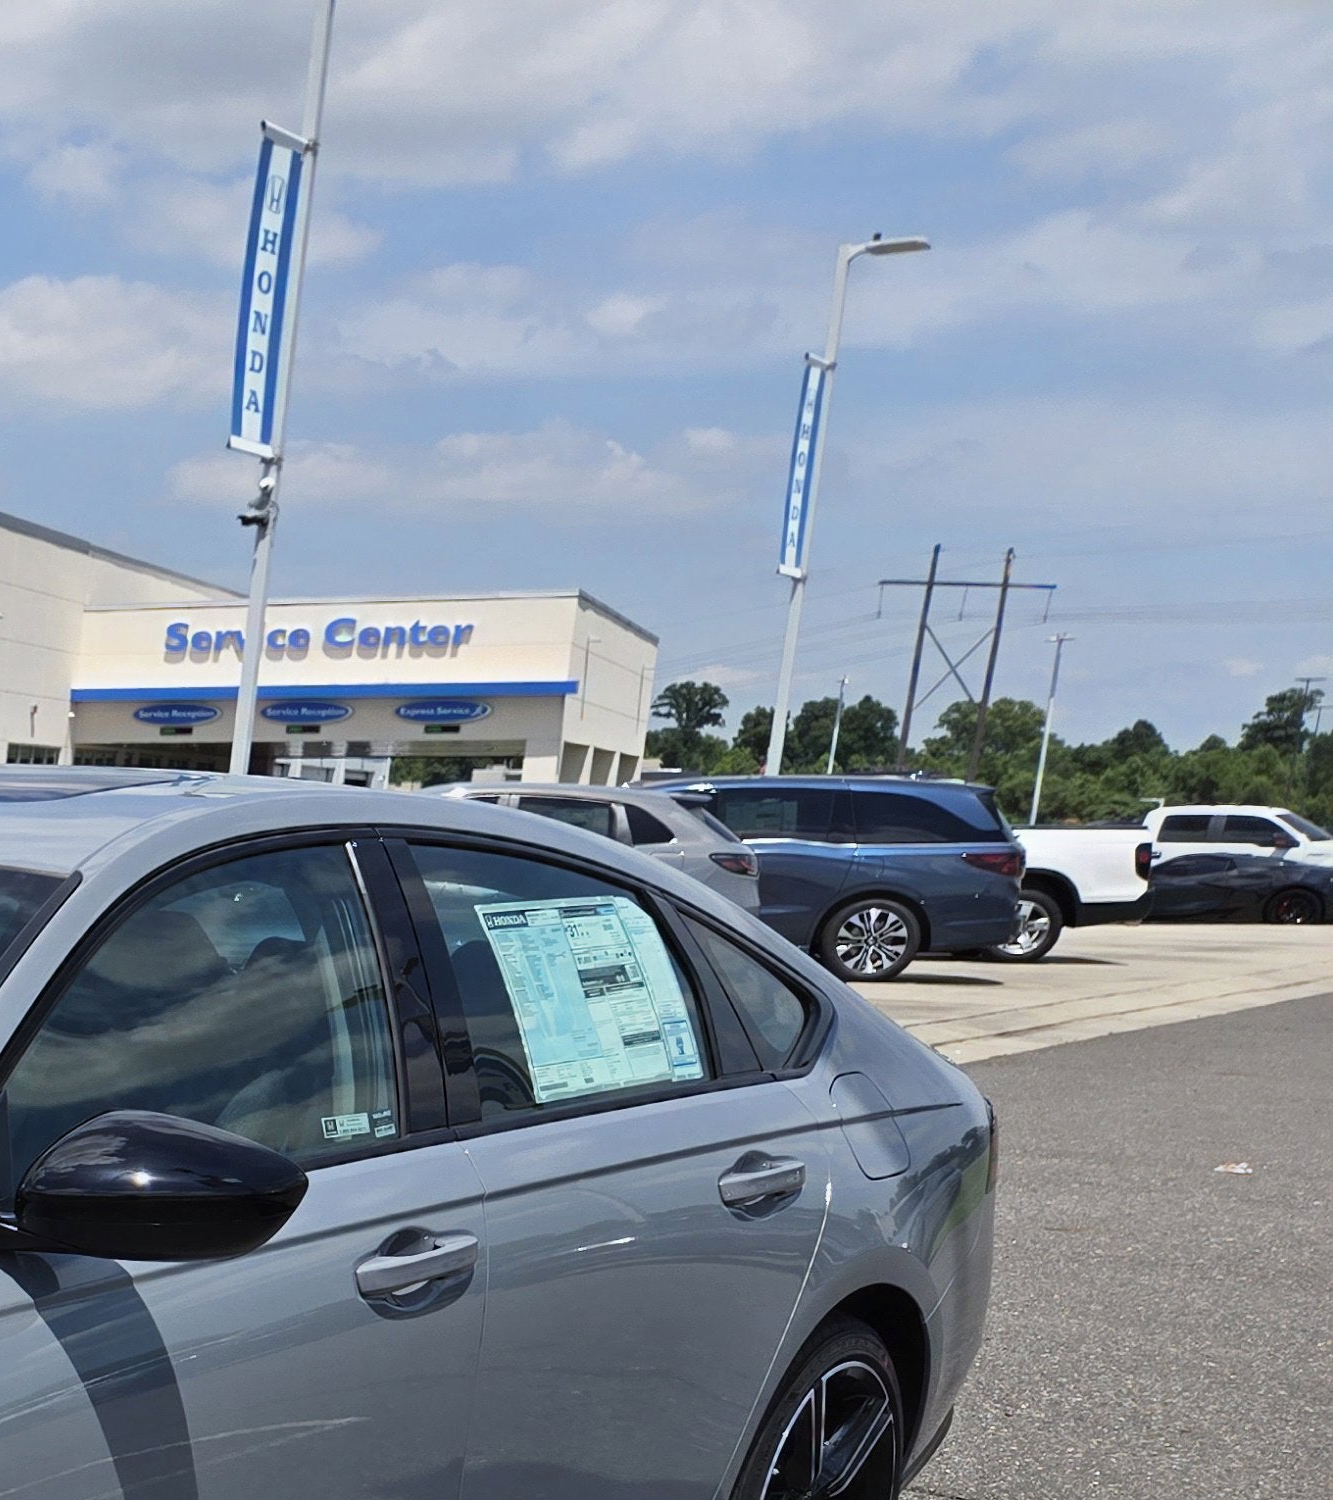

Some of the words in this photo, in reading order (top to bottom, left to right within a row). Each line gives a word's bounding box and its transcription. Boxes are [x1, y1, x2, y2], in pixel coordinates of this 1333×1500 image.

[244, 228, 278, 414] HONDA
[787, 423, 810, 548] HONDA
[165, 622, 311, 651] Servce
[323, 617, 475, 649] Center
[138, 709, 170, 719] Service
[171, 710, 215, 720] Reception
[266, 706, 299, 716] Service
[300, 707, 346, 717] Reception
[399, 706, 434, 717] Express
[436, 706, 471, 715] Service
[493, 914, 528, 927] HONDA
